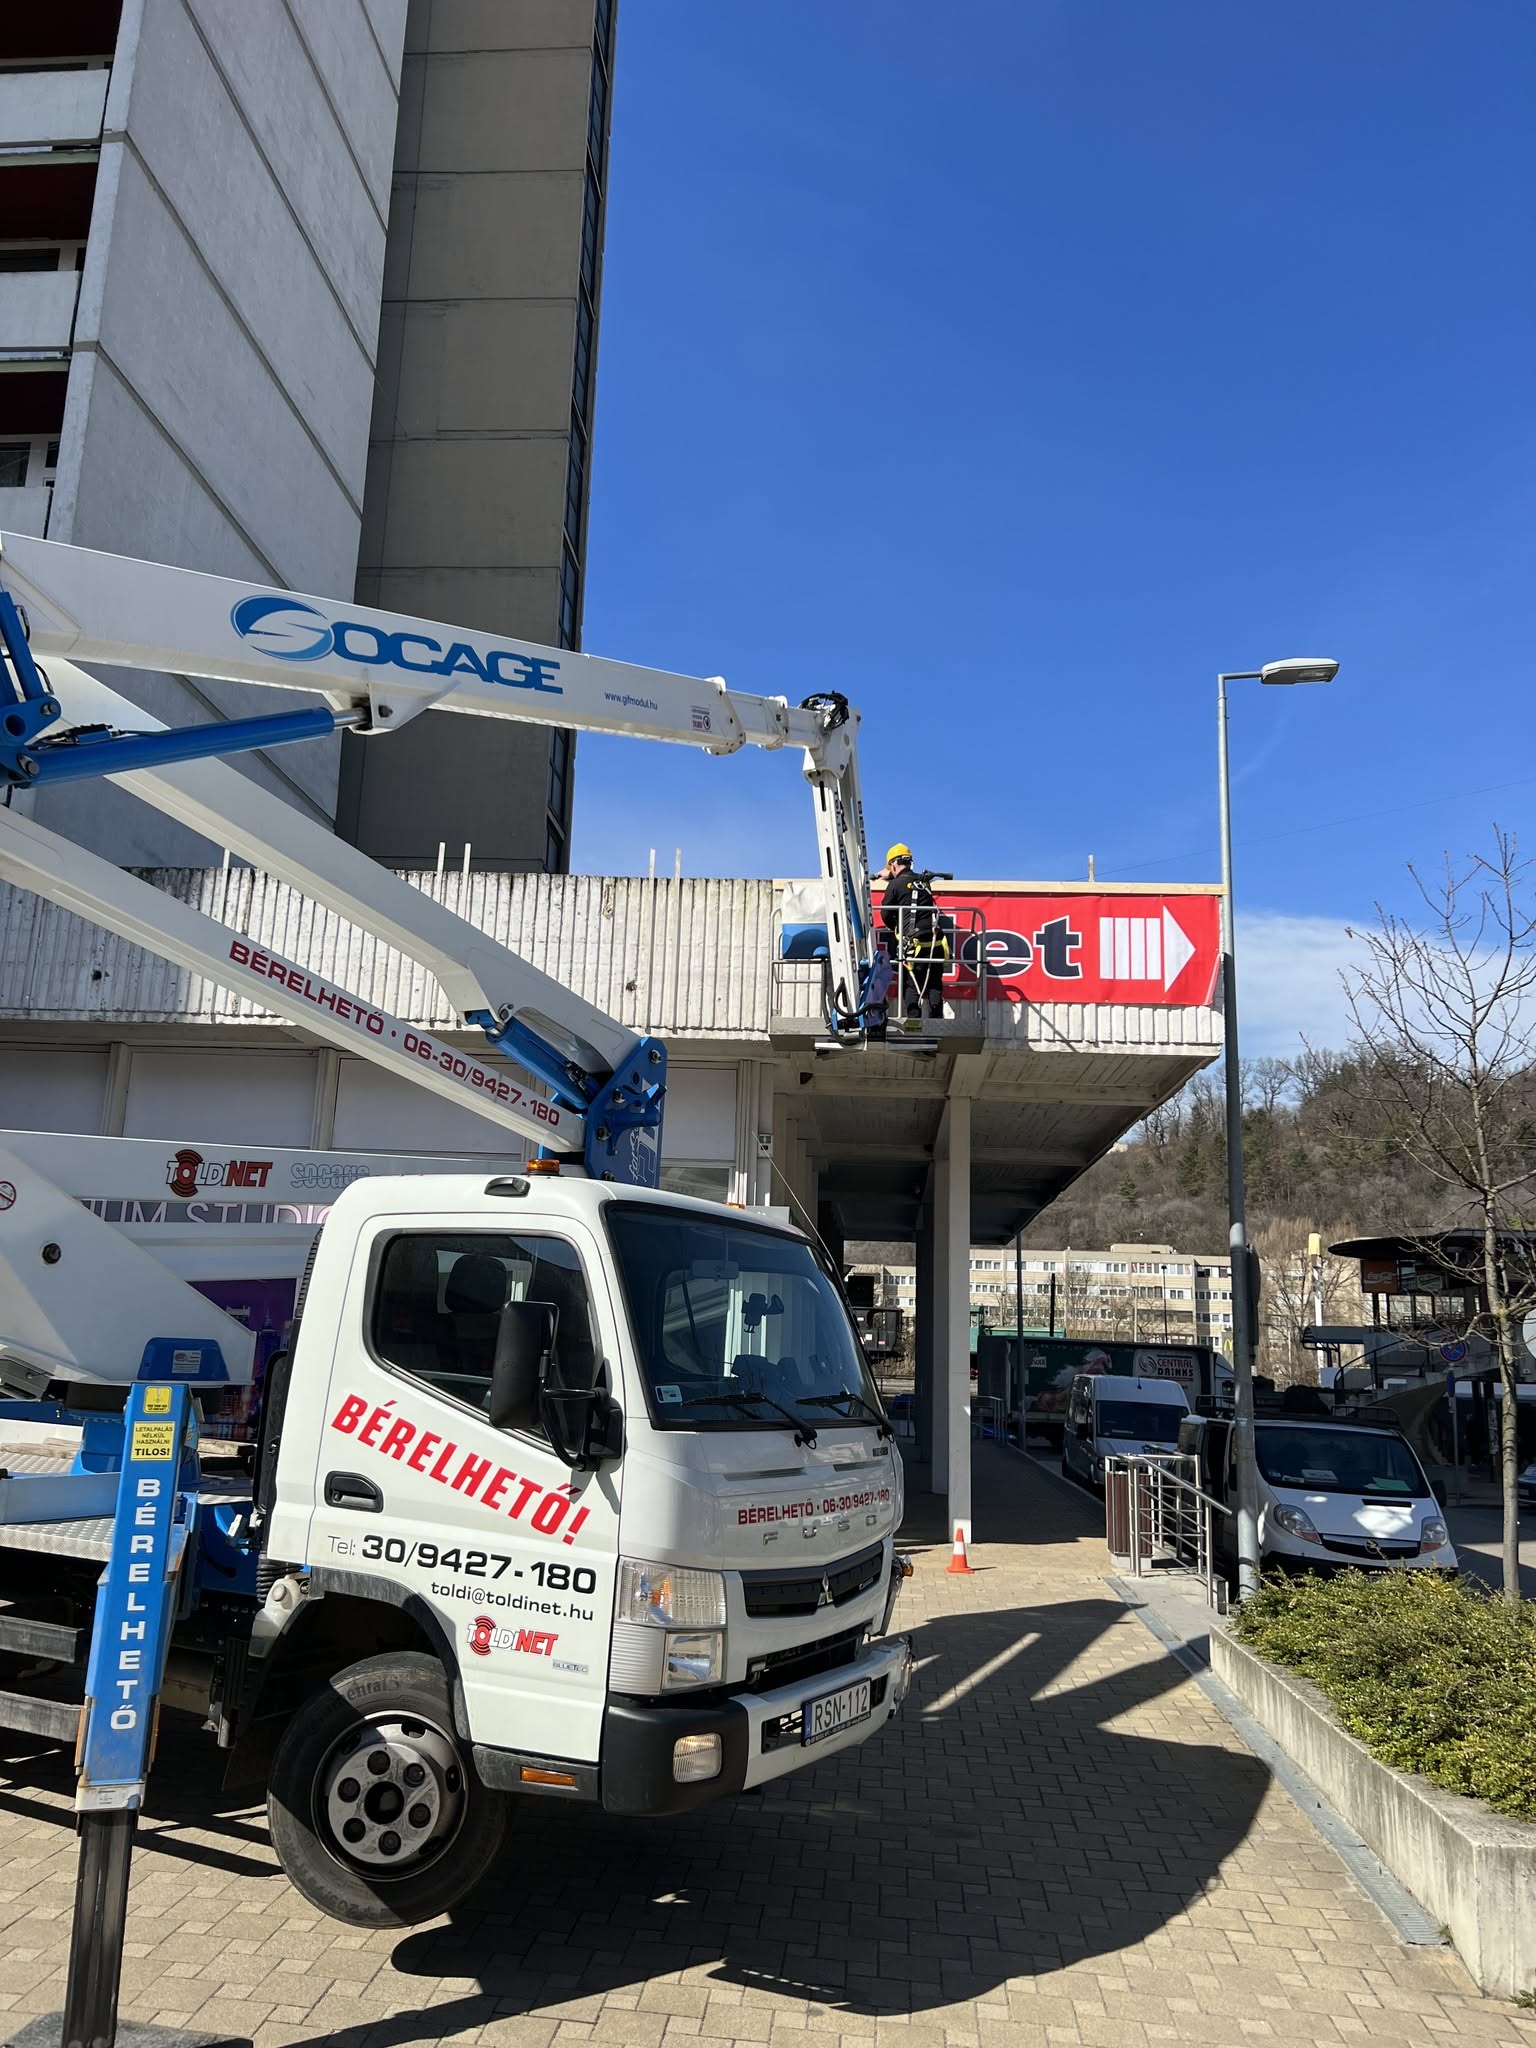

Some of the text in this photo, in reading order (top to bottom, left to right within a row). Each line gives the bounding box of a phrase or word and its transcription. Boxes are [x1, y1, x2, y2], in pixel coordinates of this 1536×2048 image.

[230, 594, 564, 695] SOCAGE
[228, 940, 561, 1127] BÉRELHETŐ 06-30/9427-180
[165, 1153, 274, 1194] TOLDINET
[134, 1448, 171, 1456] TILOS!
[331, 1393, 590, 1546] BÉRELHETŐ!
[737, 1498, 814, 1525] BÉRELHETŐ
[763, 1513, 878, 1545] FUSO
[327, 1534, 596, 1594] Tel: 30/9427-180
[110, 1478, 161, 1731] BÉRELHETŐ
[431, 1582, 594, 1621] toldi@toldinet.hu
[466, 1616, 559, 1656] TOLDINET
[814, 1685, 868, 1733] RSN-112
